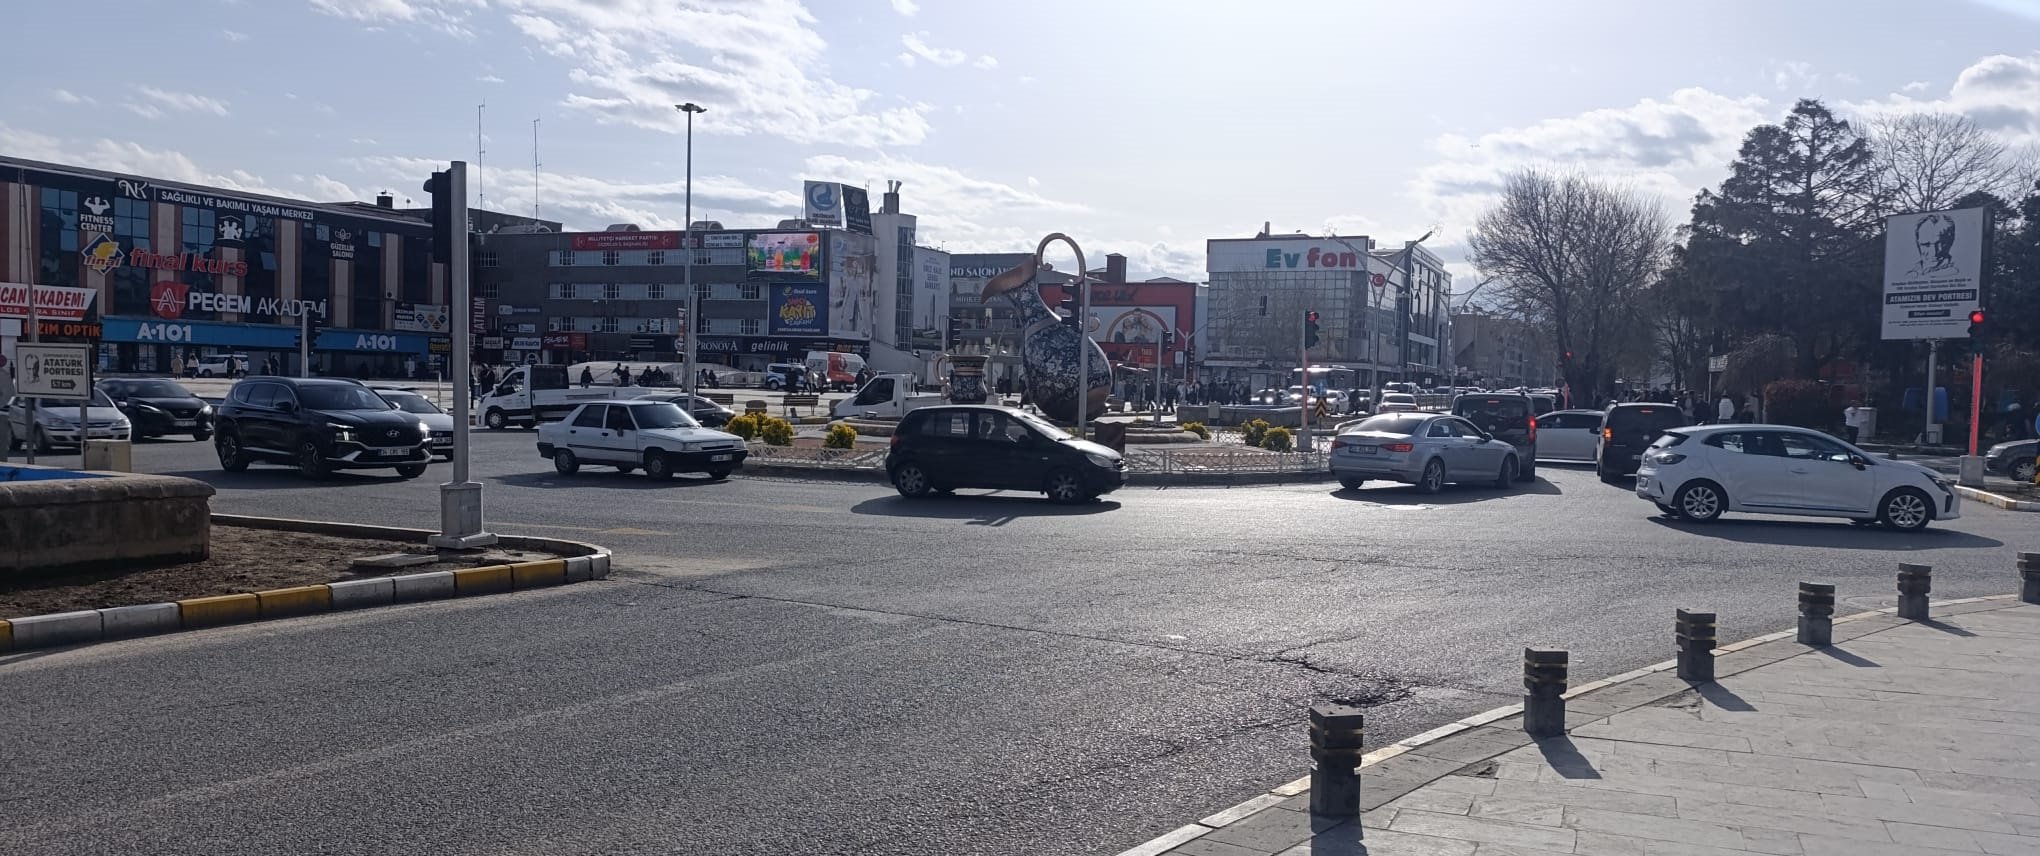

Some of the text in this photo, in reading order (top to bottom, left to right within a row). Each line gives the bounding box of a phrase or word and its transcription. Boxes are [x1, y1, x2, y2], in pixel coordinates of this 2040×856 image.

[161, 190, 314, 220] SAĞLIKLI VE BAKIMLI YAŞAM MERKEZİ
[80, 213, 114, 225] FITNESS
[80, 222, 113, 233] CENTER
[130, 248, 249, 277] final kurs
[189, 292, 251, 314] PEGEM
[750, 340, 790, 352] gelinlik
[43, 358, 84, 368] ATATÜRK
